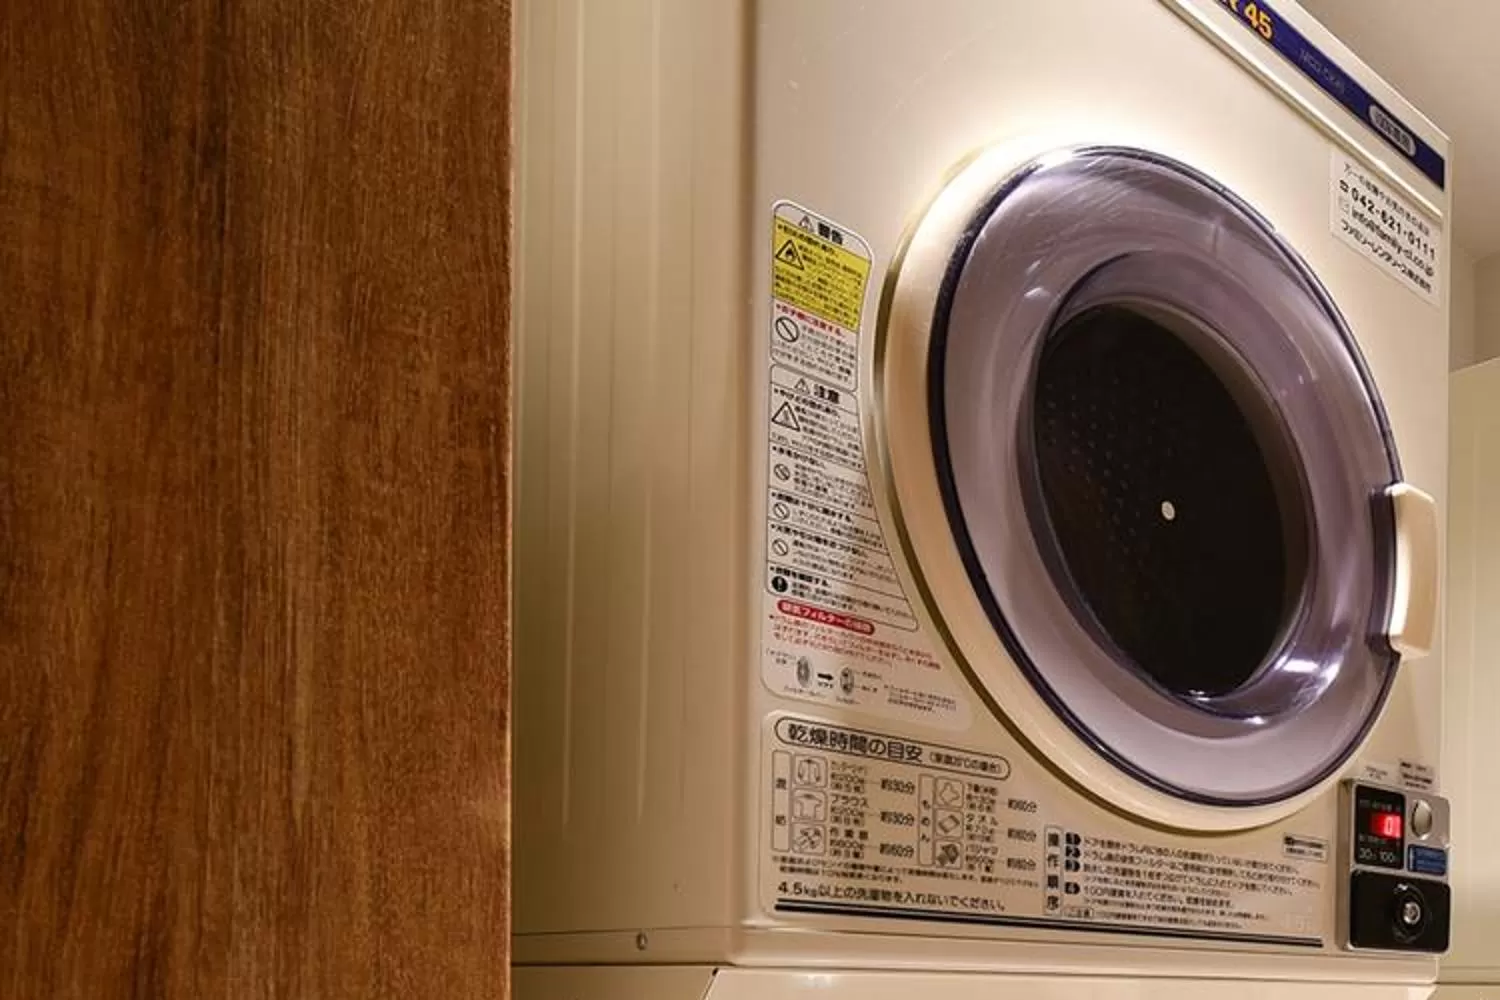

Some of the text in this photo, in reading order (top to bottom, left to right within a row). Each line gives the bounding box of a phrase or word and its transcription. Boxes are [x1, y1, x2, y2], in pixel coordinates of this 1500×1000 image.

[1244, 2, 1273, 40] 45
[788, 722, 924, 763] 乾燥時間の目安
